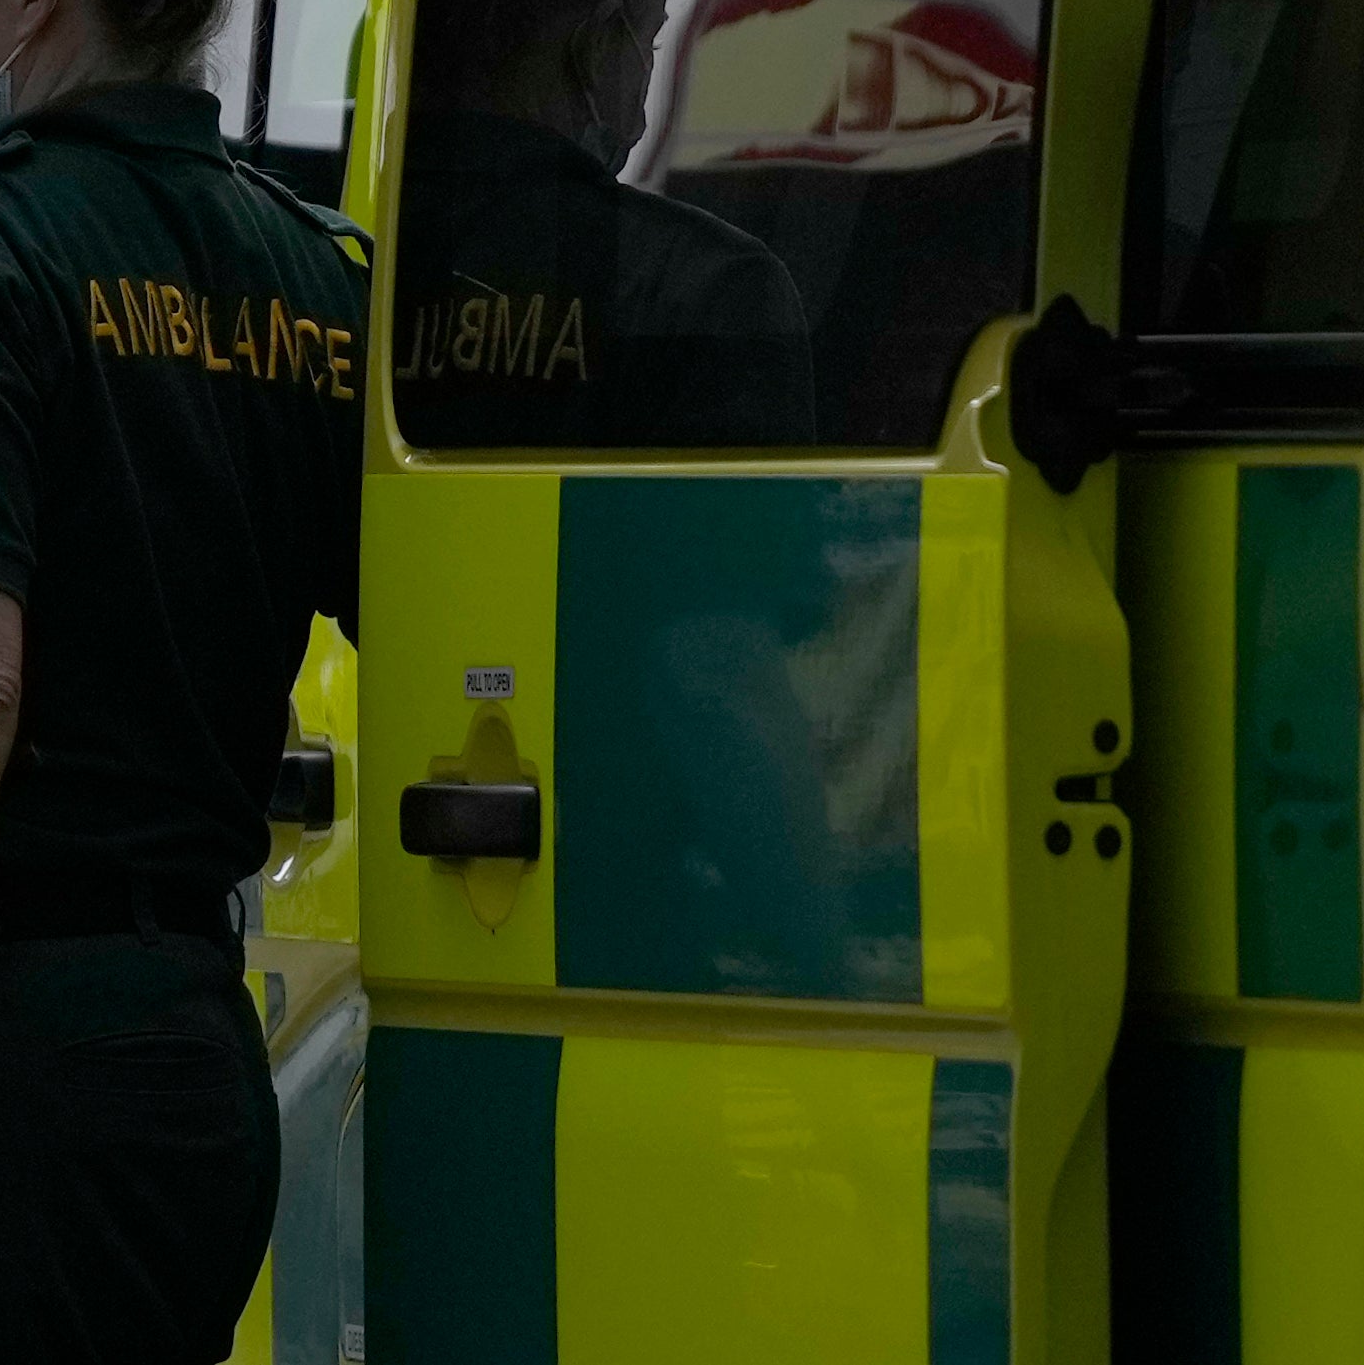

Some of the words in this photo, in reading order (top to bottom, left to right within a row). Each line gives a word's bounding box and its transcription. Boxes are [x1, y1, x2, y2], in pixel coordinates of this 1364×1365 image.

[466, 673, 482, 692] PULL
[484, 672, 492, 692] TO
[493, 672, 510, 692] OPEN
